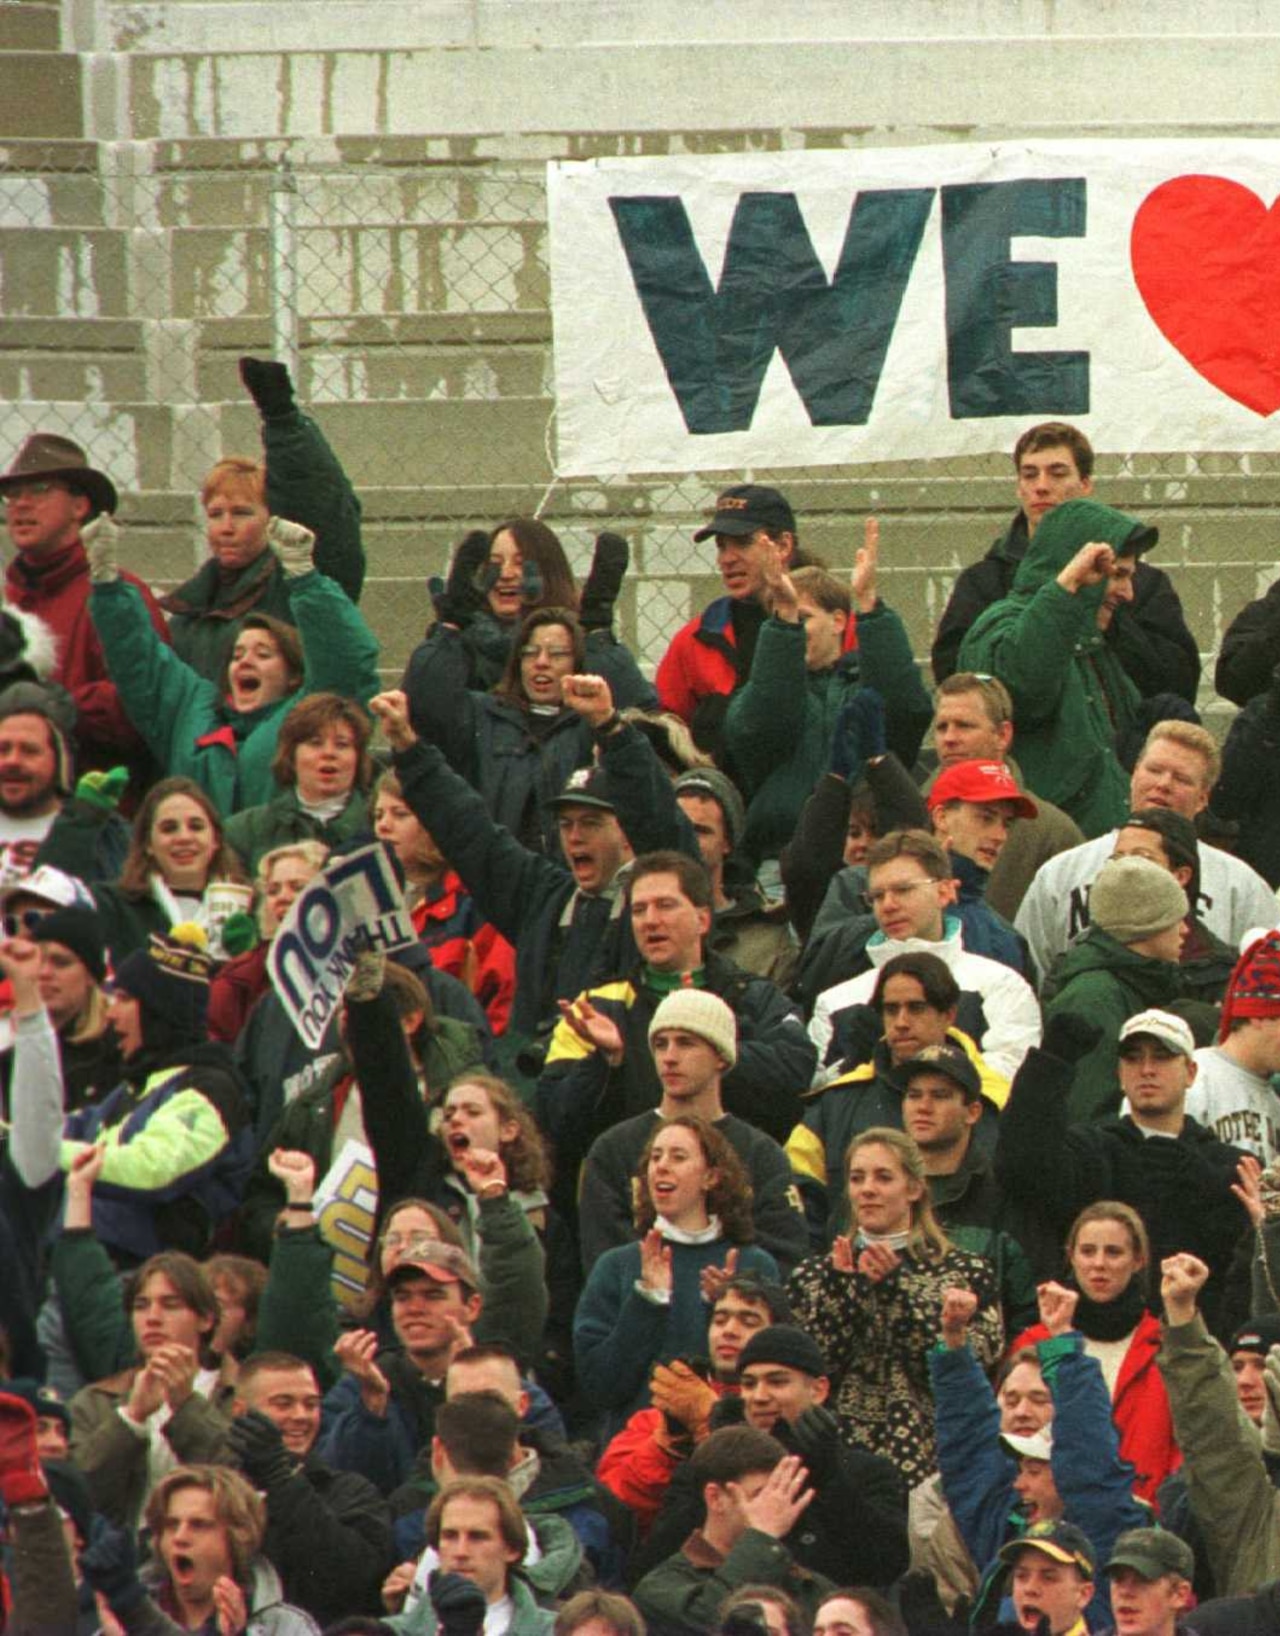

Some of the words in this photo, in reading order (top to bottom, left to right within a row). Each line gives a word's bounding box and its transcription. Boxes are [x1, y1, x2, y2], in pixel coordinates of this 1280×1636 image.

[607, 177, 1090, 435] WE
[275, 850, 399, 1014] LOU
[302, 984, 337, 1042] YOU
